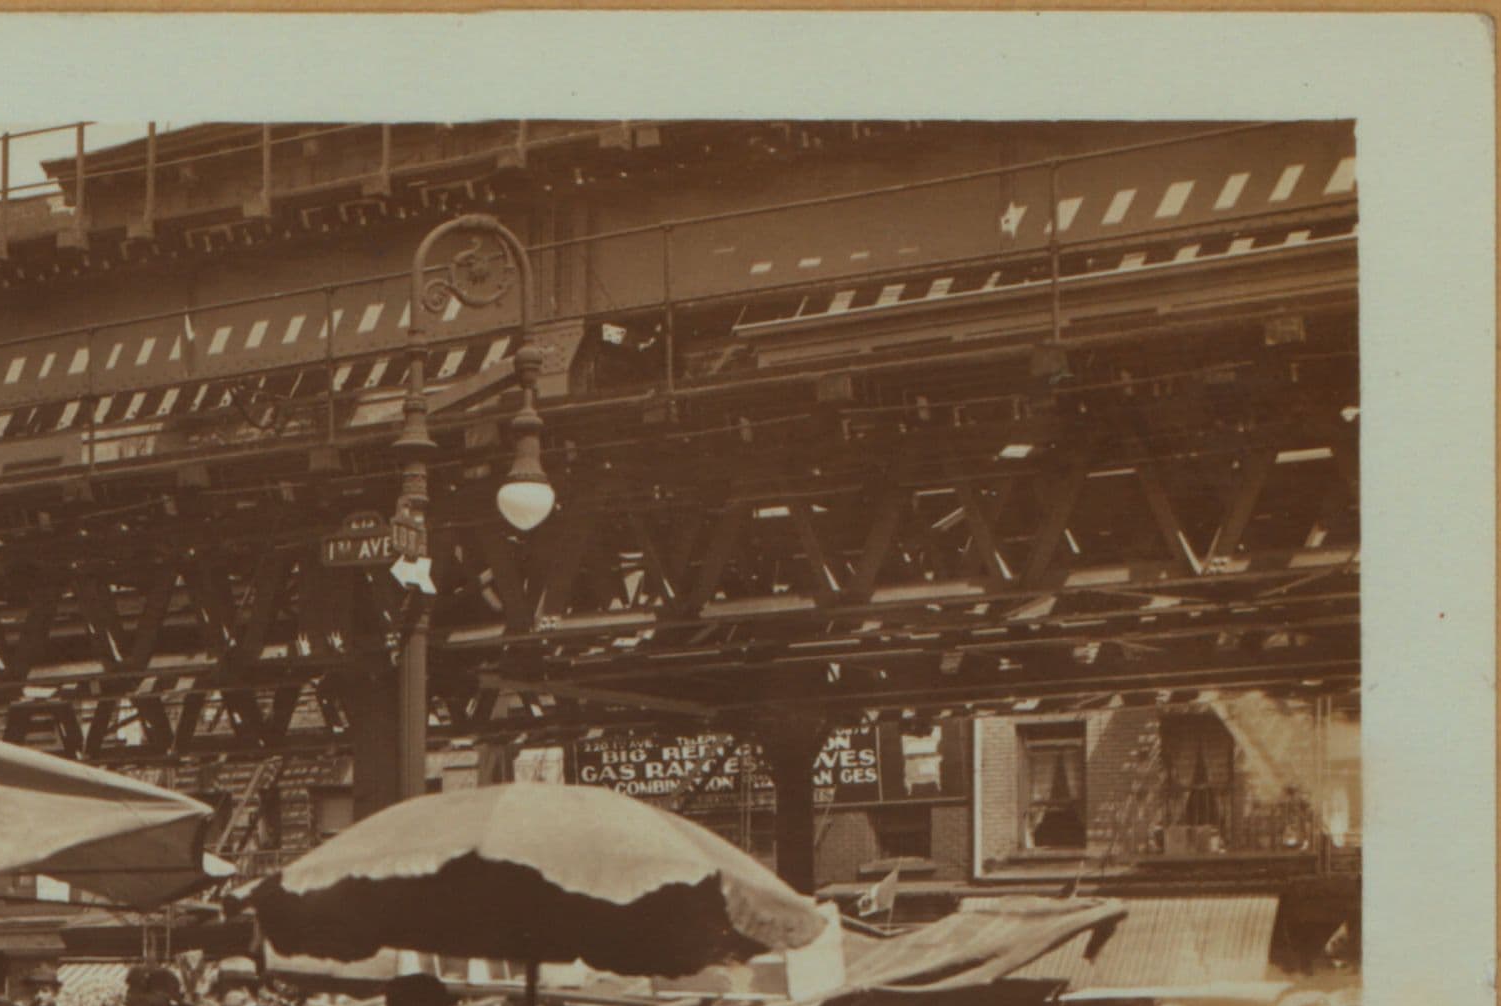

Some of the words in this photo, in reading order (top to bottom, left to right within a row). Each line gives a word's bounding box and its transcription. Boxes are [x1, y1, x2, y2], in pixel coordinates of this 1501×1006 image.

[357, 535, 392, 560] AVE
[602, 748, 648, 765] BIG
[581, 763, 636, 783] GAS
